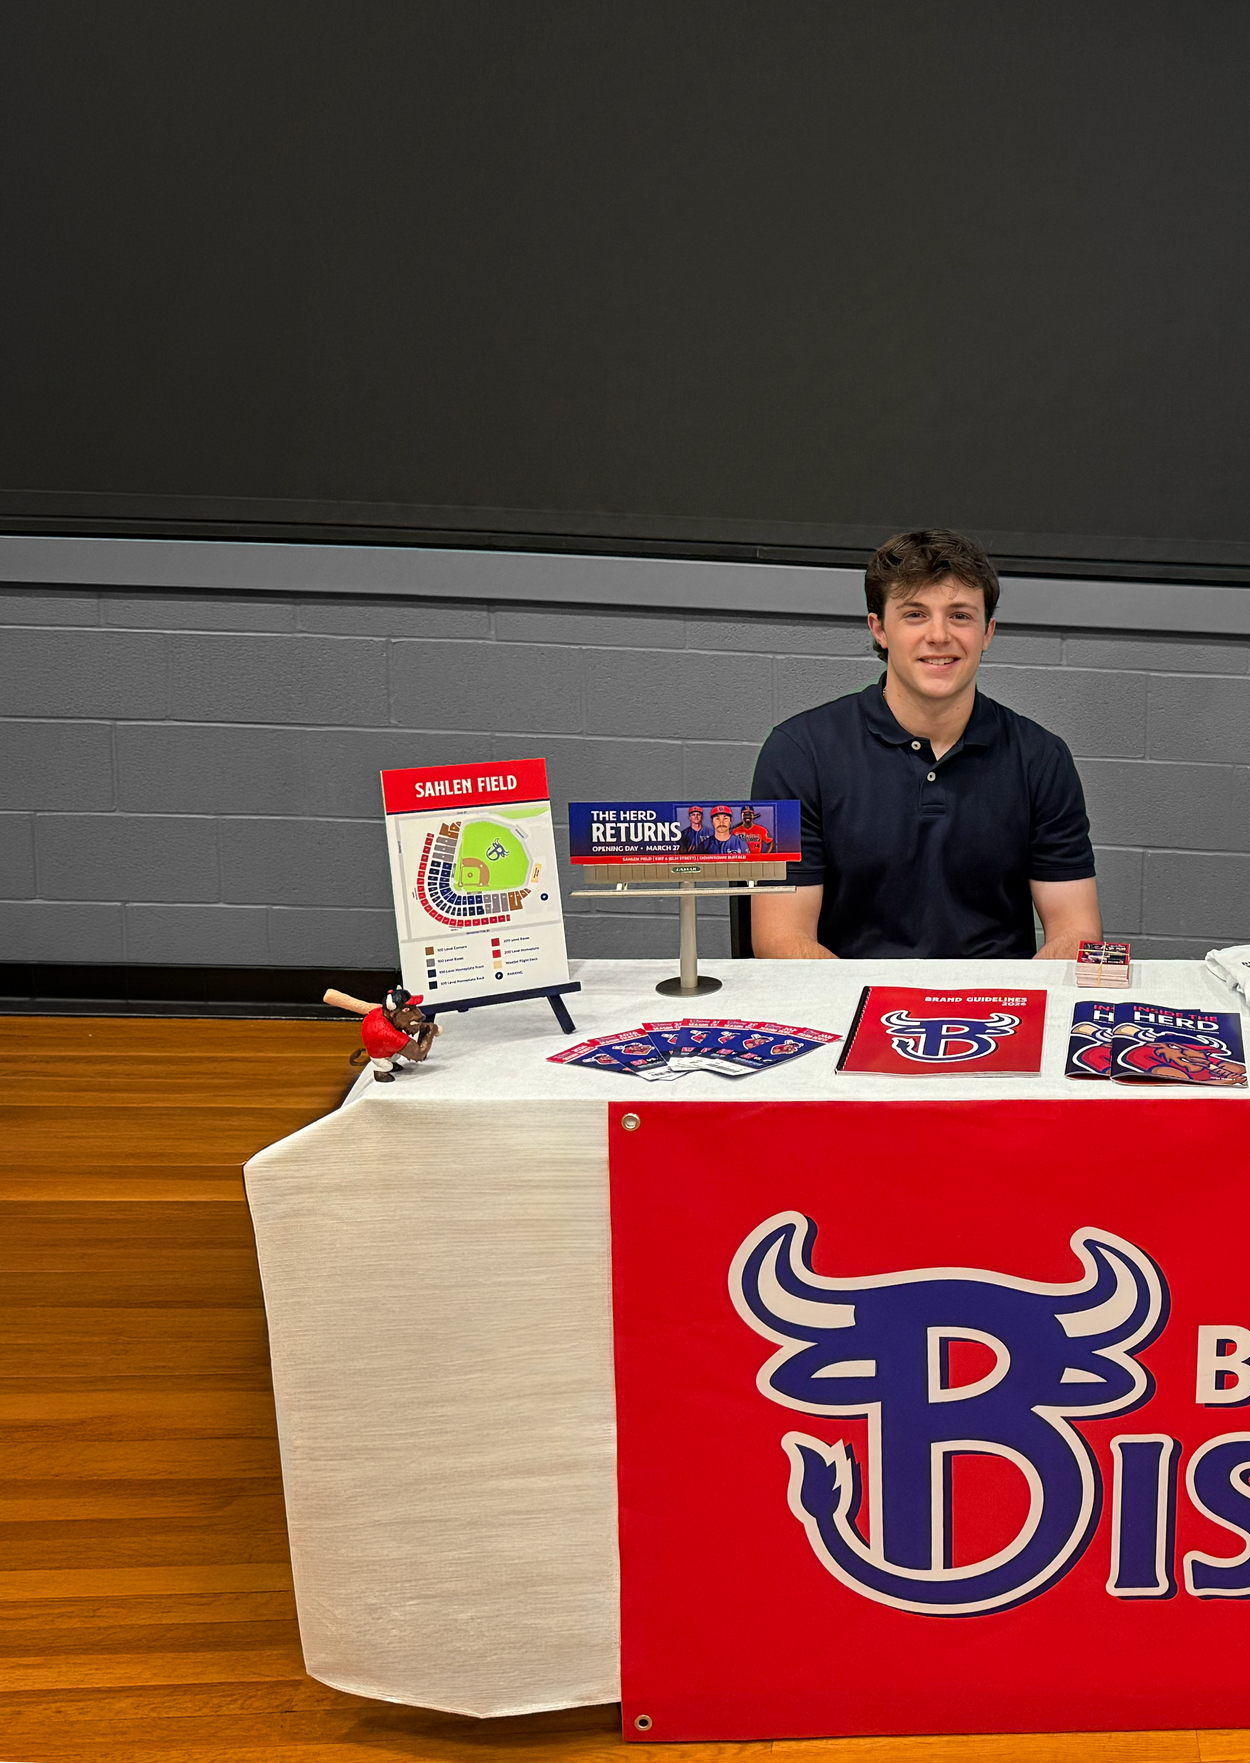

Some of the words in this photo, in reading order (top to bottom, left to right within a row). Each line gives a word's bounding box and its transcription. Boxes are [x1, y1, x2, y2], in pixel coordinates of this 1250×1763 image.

[415, 779, 473, 798] SAHLEN
[477, 775, 517, 793] FIELD
[591, 810, 617, 821] THE
[620, 810, 657, 821] HERD
[592, 822, 682, 842] RETURNS
[1133, 1005, 1183, 1018] INSIDE
[1188, 1014, 1217, 1022] THE
[1134, 1011, 1219, 1031] HERD
